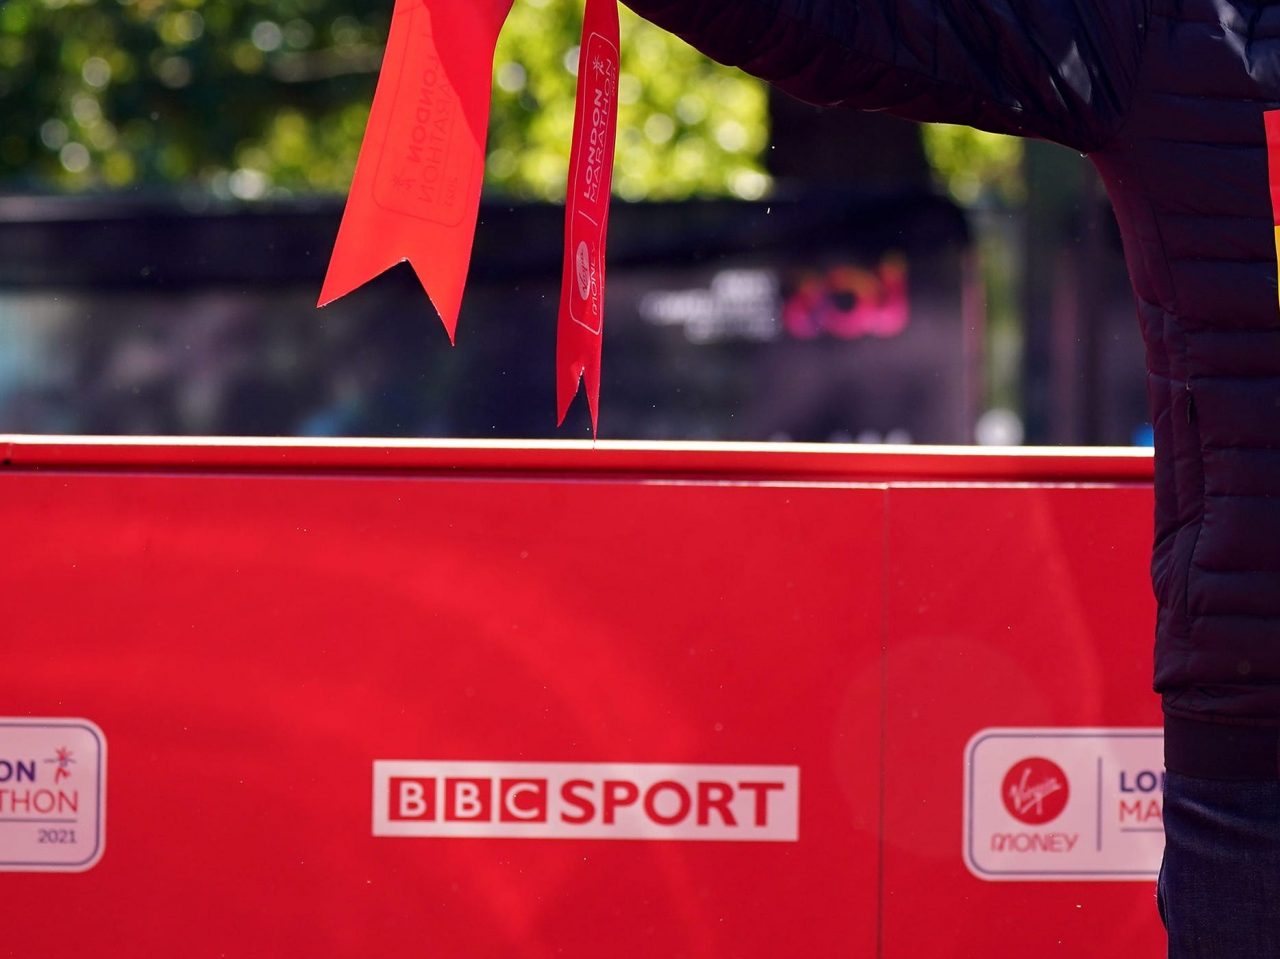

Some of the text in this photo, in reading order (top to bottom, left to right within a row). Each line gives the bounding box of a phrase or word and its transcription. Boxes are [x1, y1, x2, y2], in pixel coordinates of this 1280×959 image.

[584, 89, 603, 199] LONDON
[591, 58, 612, 203] MARATHON
[392, 779, 784, 827] BBC SPORT
[37, 829, 77, 844] 2021
[990, 833, 1079, 852] MONEY
